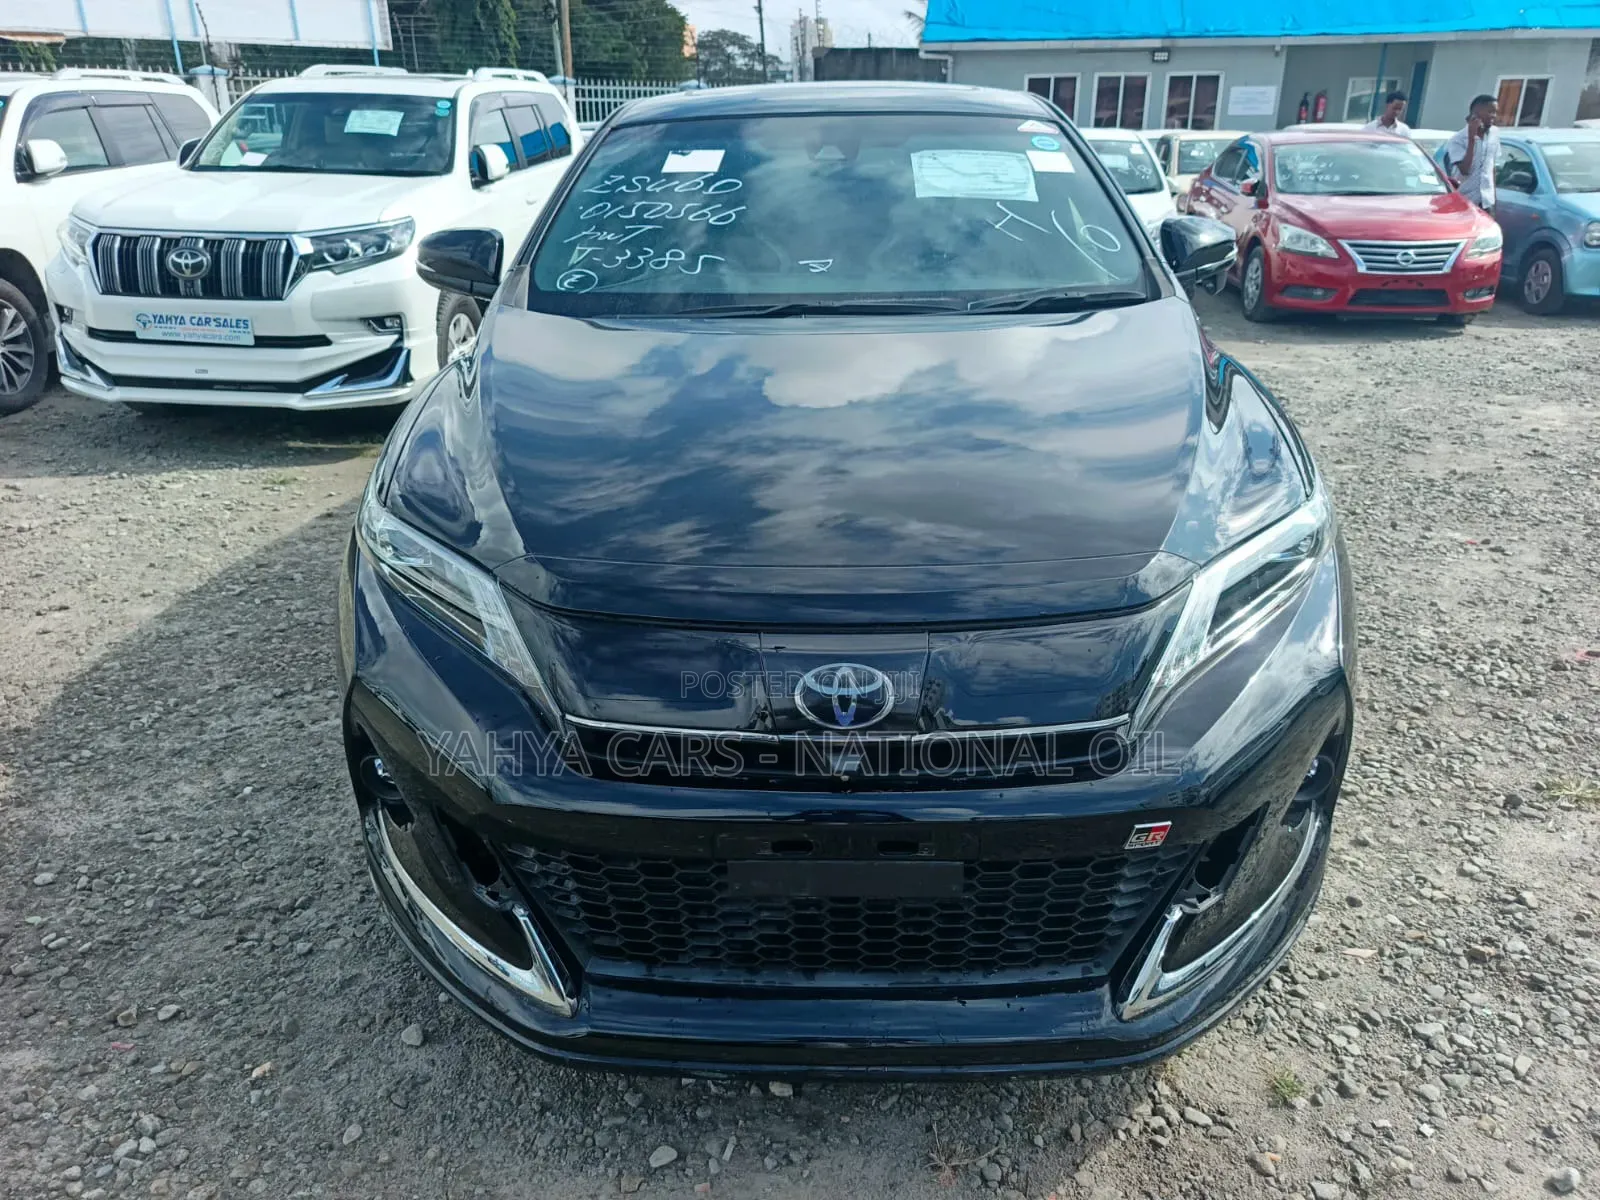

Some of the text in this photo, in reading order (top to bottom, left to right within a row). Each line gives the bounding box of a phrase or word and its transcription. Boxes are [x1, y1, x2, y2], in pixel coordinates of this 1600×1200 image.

[152, 313, 186, 326] YAHYA
[189, 316, 212, 327] CAR
[214, 317, 249, 329] SALES
